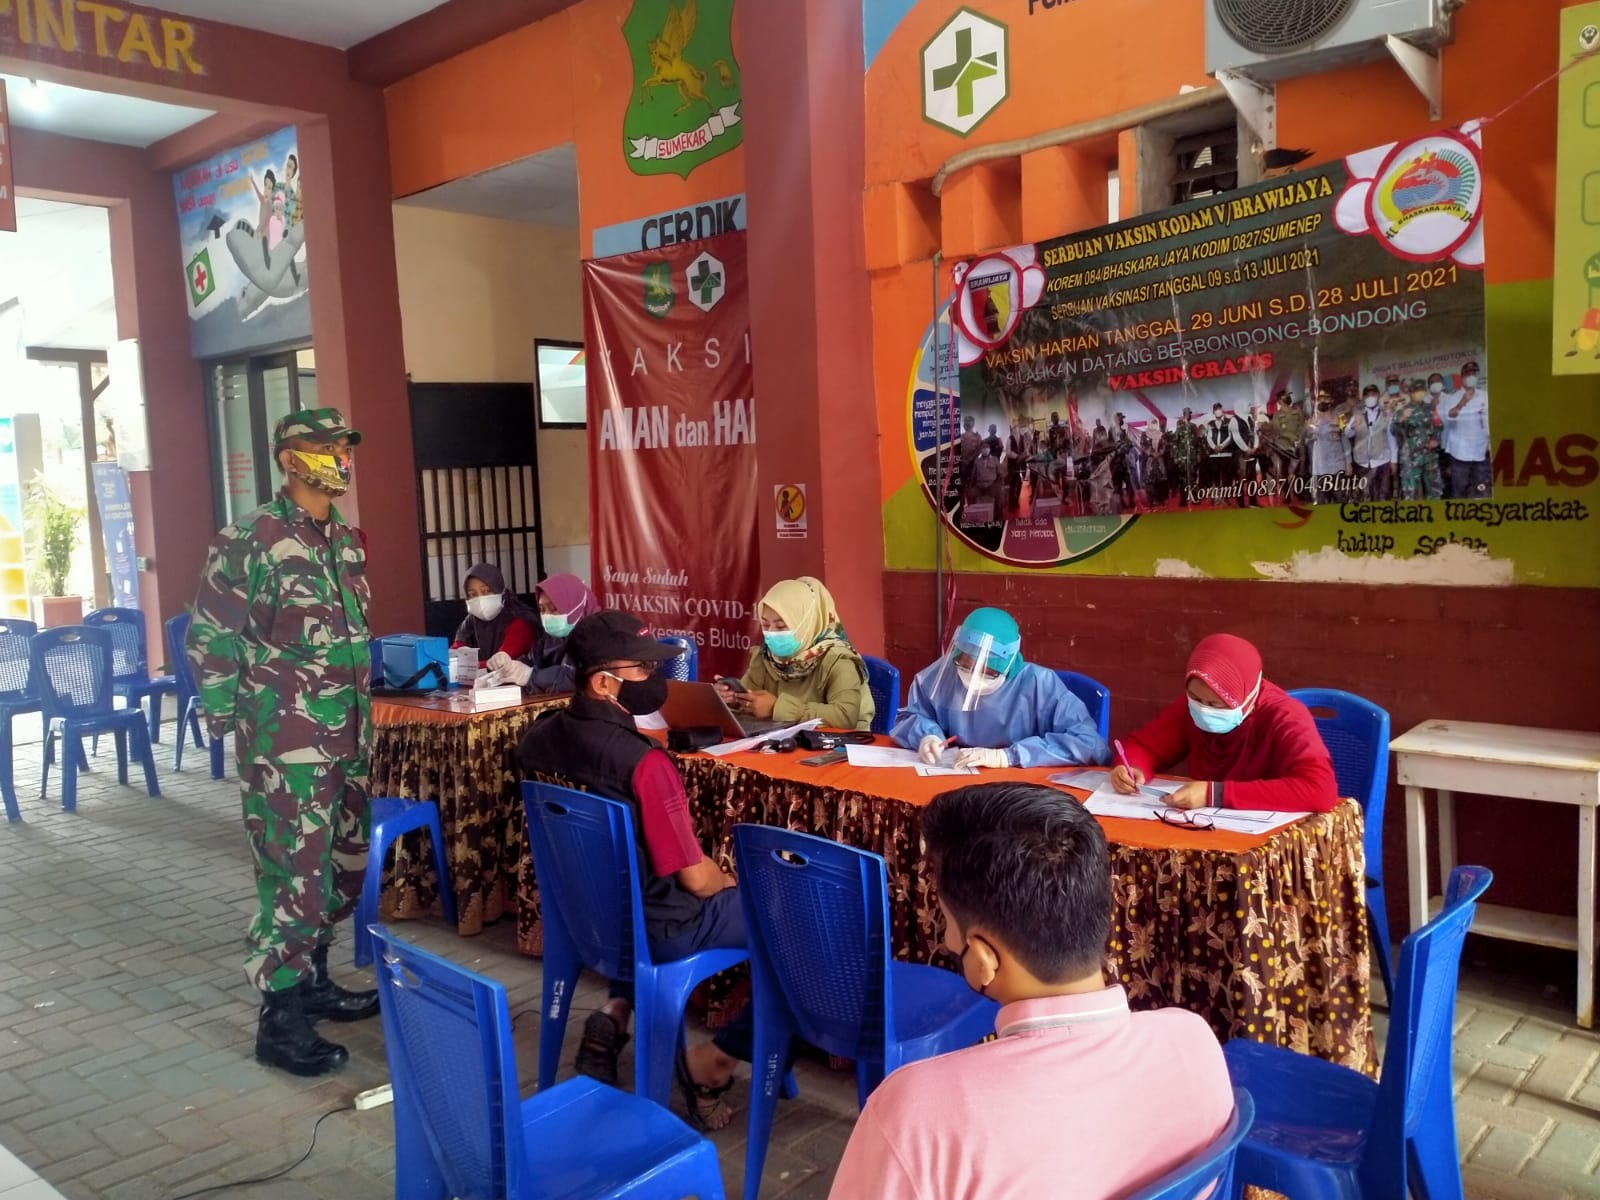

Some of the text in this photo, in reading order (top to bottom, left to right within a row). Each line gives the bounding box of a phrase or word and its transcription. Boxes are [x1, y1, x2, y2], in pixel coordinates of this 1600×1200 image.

[658, 128, 707, 157] SUMEKAR
[641, 198, 742, 251] CERDIK
[1044, 176, 1333, 267] SERBUAN VAKSIN KODAM V/BRAWIJAYA
[1047, 214, 1322, 292] KOREM 084/BHASKARA JAYA KODIM 0827/SUMENEP
[1051, 249, 1320, 320] SERBUAN VAKSINASI TANGGAL 09 s.d 13 JULI 2021
[985, 348, 1036, 369] VAKSIN
[1039, 334, 1100, 357] HARIAN
[1104, 319, 1186, 345] TANGGAL
[1191, 312, 1213, 331] 29
[1218, 302, 1263, 325] JUNI
[1318, 287, 1343, 308] 28
[1350, 276, 1399, 302] JULI
[1407, 265, 1458, 292] 2021
[1006, 300, 1427, 386] SILAHKAN DATANG BERBONDONG-BONDONG
[1109, 351, 1273, 392] VAKSIN GRATIS
[675, 413, 709, 448] dan
[1183, 471, 1368, 503] Koramil 0827/04 Bluto
[1340, 498, 1590, 527] Gerakan masyarakat
[603, 565, 639, 586] Saya
[606, 593, 759, 621] DIVAKSIN COVID-1
[649, 623, 751, 650] kesmas Bluto
